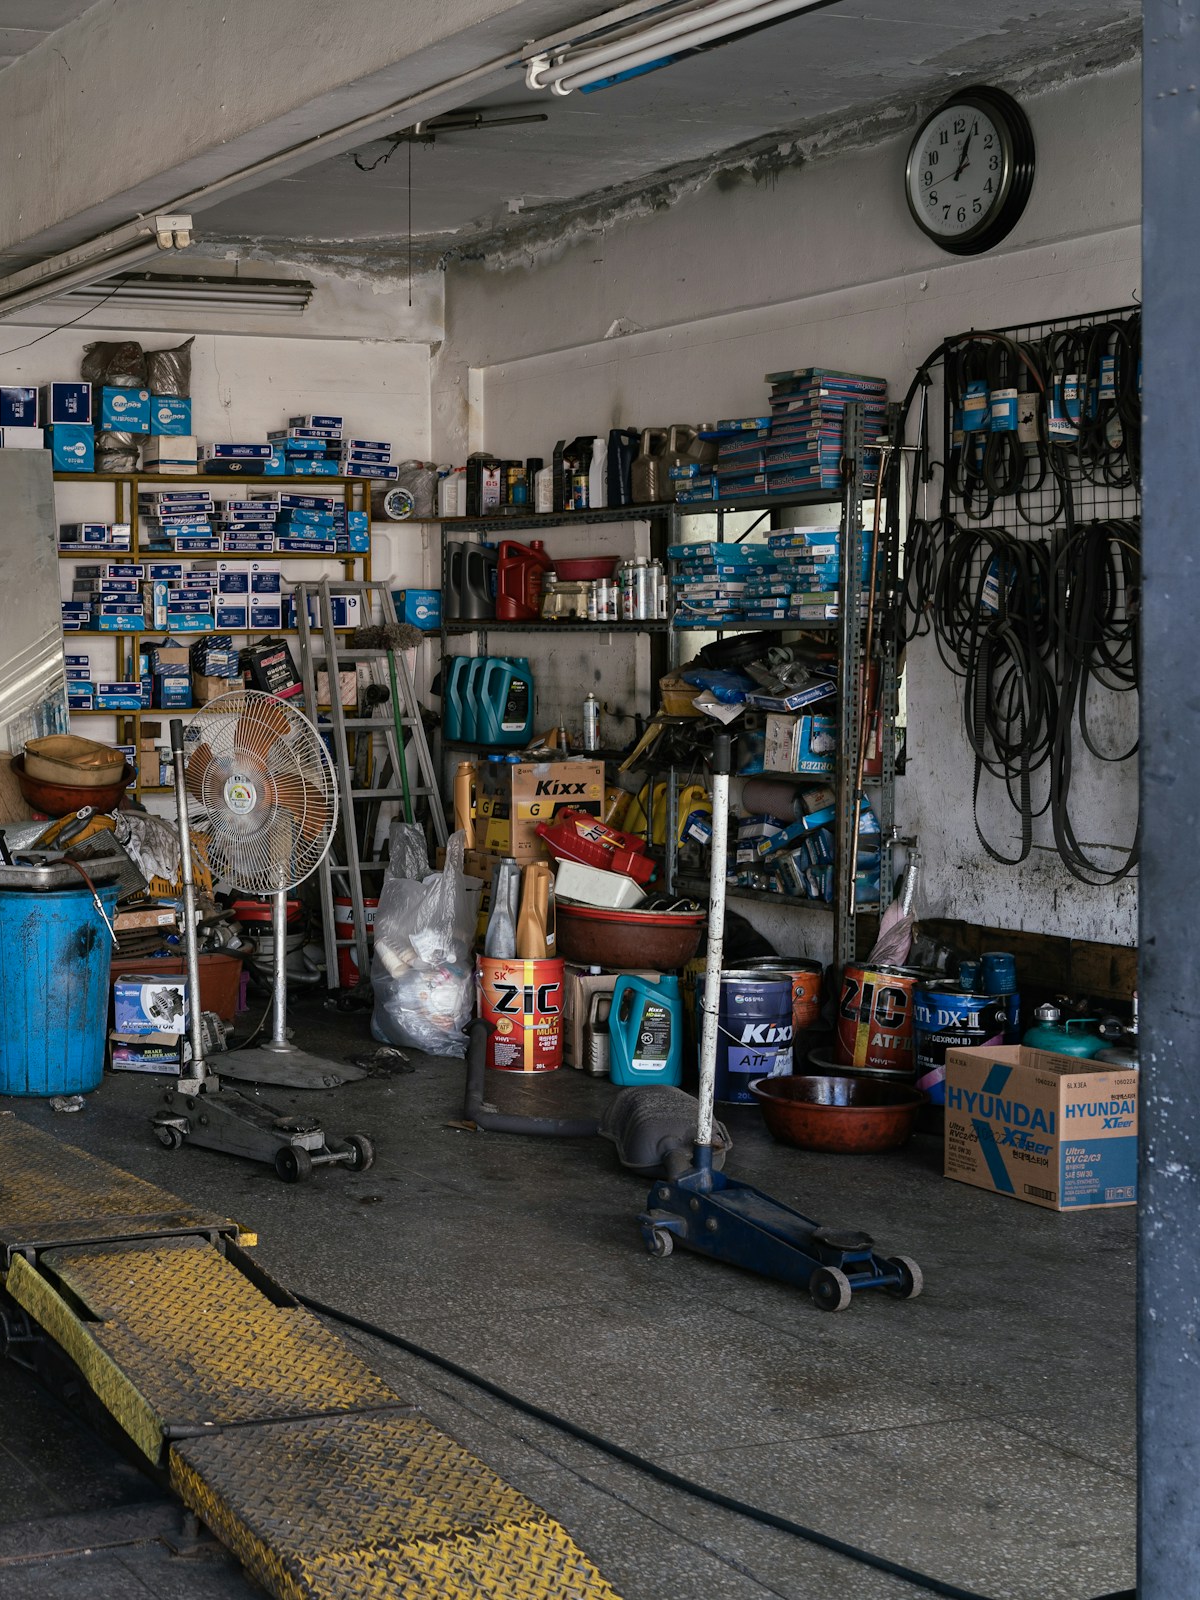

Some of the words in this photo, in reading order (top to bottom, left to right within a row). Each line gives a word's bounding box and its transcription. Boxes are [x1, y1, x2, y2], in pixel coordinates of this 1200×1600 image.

[953, 118, 966, 135] 12
[973, 121, 980, 136] 1
[939, 130, 949, 145] 11
[983, 134, 993, 150] 2
[928, 150, 939, 166] 10
[989, 155, 999, 171] 3
[924, 171, 933, 186] 9
[983, 177, 993, 194] 4
[928, 191, 938, 206] 8
[972, 197, 982, 213] 5
[942, 204, 951, 220] 7
[957, 207, 966, 222] 6
[801, 761, 835, 771] ORIZER
[535, 780, 588, 796] Kixx
[530, 803, 541, 816] G
[494, 971, 507, 981] SK
[839, 975, 908, 1030] ZIC
[538, 1016, 560, 1027] ATF
[537, 1027, 560, 1036] MULTI
[932, 1035, 961, 1045] DEXRON
[739, 1054, 769, 1067] ATF
[948, 1086, 1055, 1135] HYUNDAI
[1065, 1100, 1135, 1118] HYUNDAI
[949, 1121, 965, 1132] Ultra
[1101, 1116, 1134, 1130] XTeer
[1001, 1126, 1054, 1156] XTeer
[1012, 1150, 1049, 1168] 현대엑스티어
[1065, 1147, 1085, 1156] Ultra
